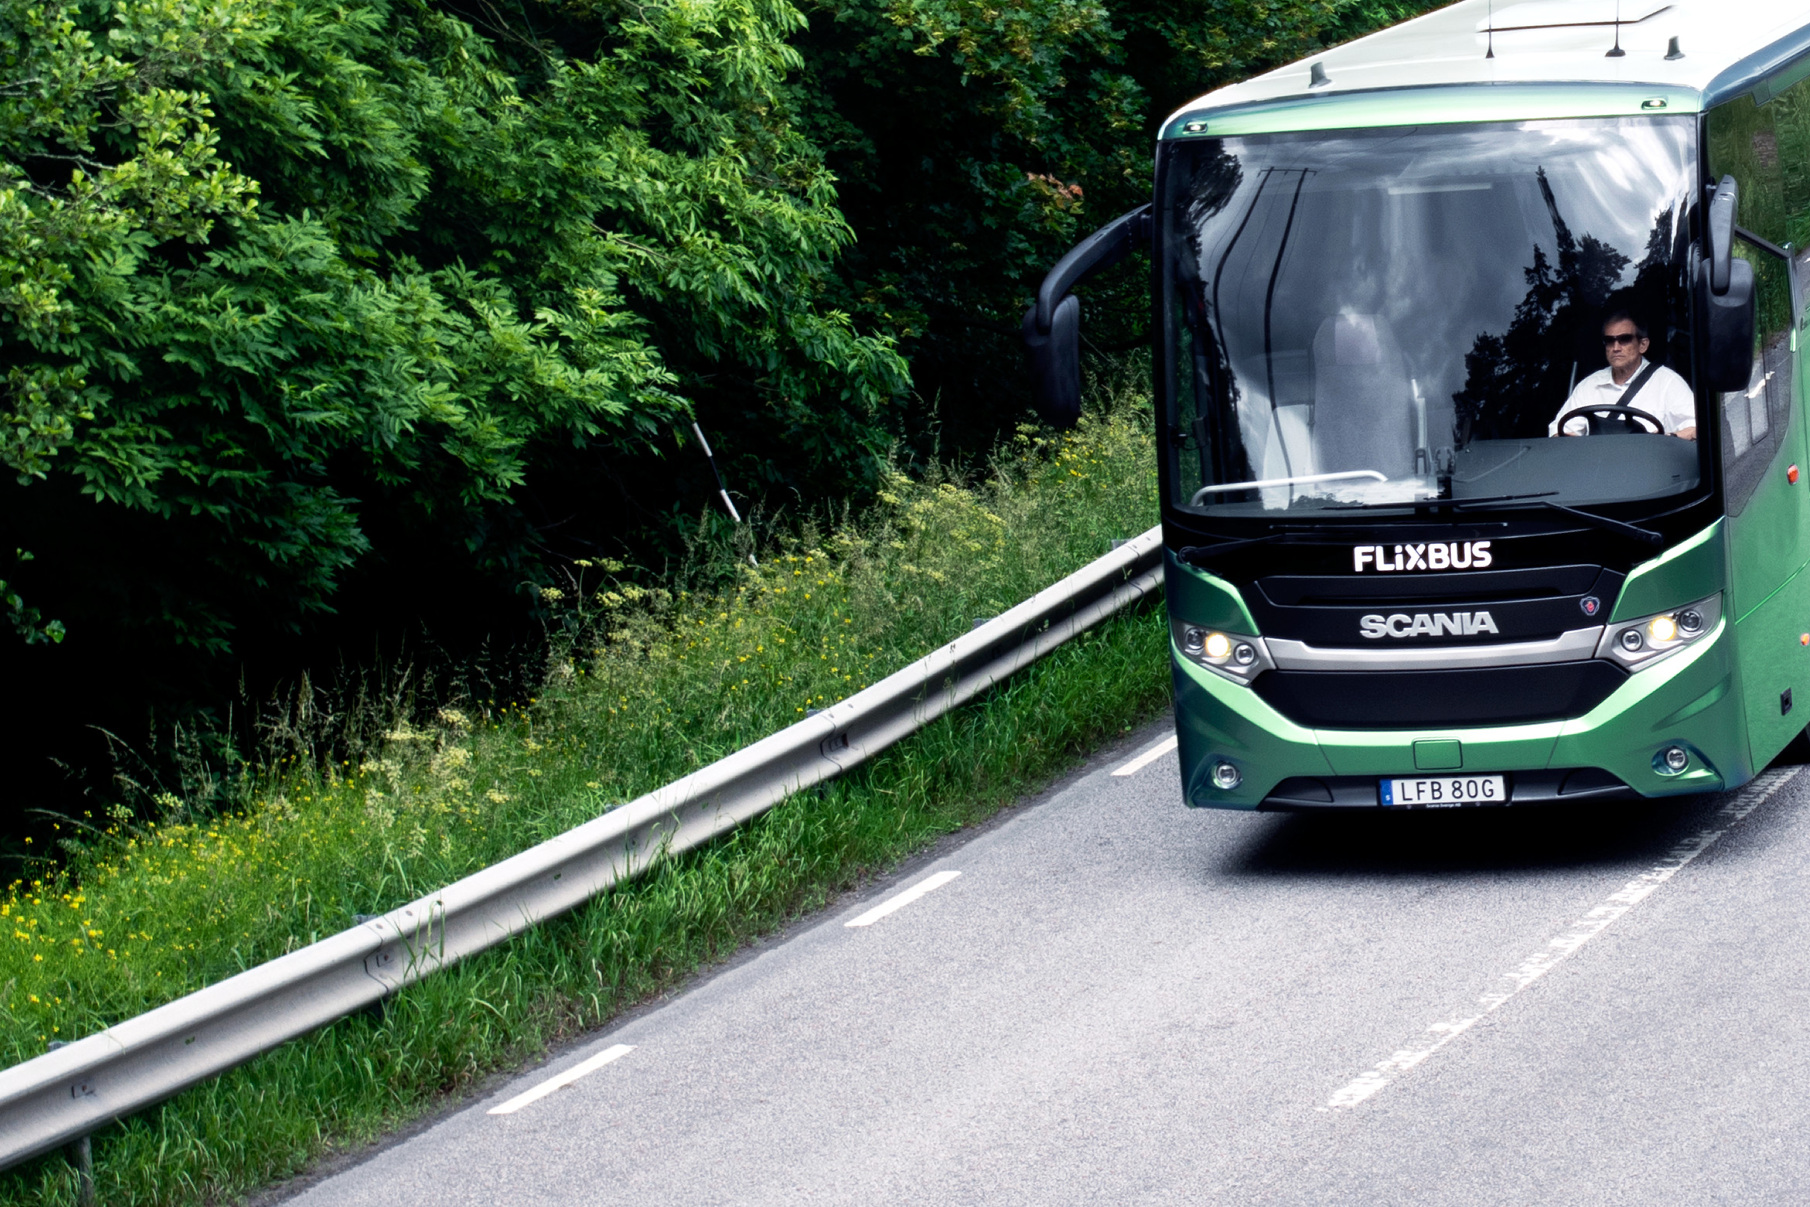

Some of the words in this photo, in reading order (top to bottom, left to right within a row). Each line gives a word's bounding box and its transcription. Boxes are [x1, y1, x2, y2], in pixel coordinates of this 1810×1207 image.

[1354, 541, 1492, 572] FLiXBUS
[1359, 611, 1499, 639] SCANIA
[1401, 781, 1442, 801] LFB
